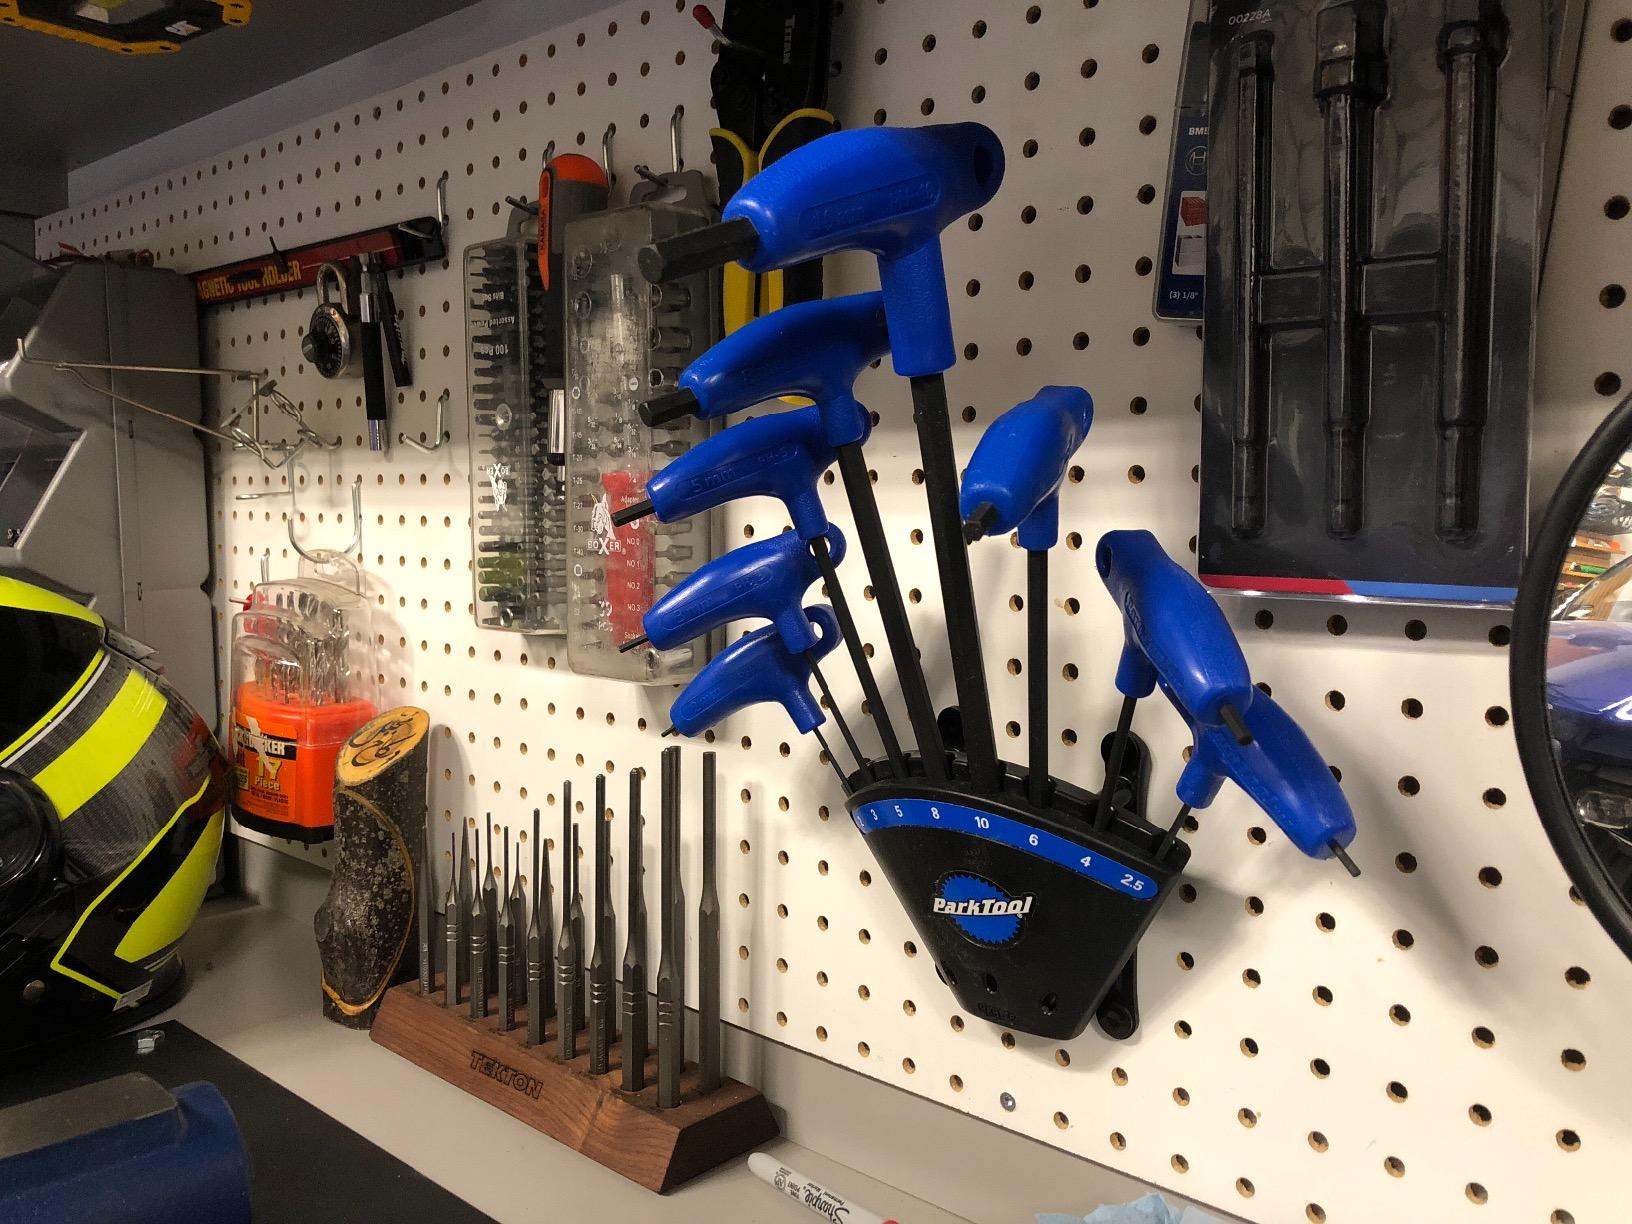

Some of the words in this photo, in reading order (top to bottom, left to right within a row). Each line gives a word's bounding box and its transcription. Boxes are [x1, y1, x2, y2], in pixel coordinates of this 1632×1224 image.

[1228, 9, 1271, 25] 00228A
[1169, 291, 1180, 300] (3)
[489, 316, 515, 327] Assorted
[495, 344, 508, 355] 100
[587, 537, 621, 555] BOXER
[255, 775, 281, 791] Piece
[870, 808, 878, 821] 3
[894, 805, 904, 818] 5
[930, 807, 940, 820] 8
[974, 816, 990, 829] 10
[1028, 833, 1039, 846] 6
[1080, 855, 1091, 868] 4
[1120, 873, 1144, 892] 2.5
[470, 1050, 544, 1099] TEKTON
[802, 1188, 850, 1224] Sharpie
